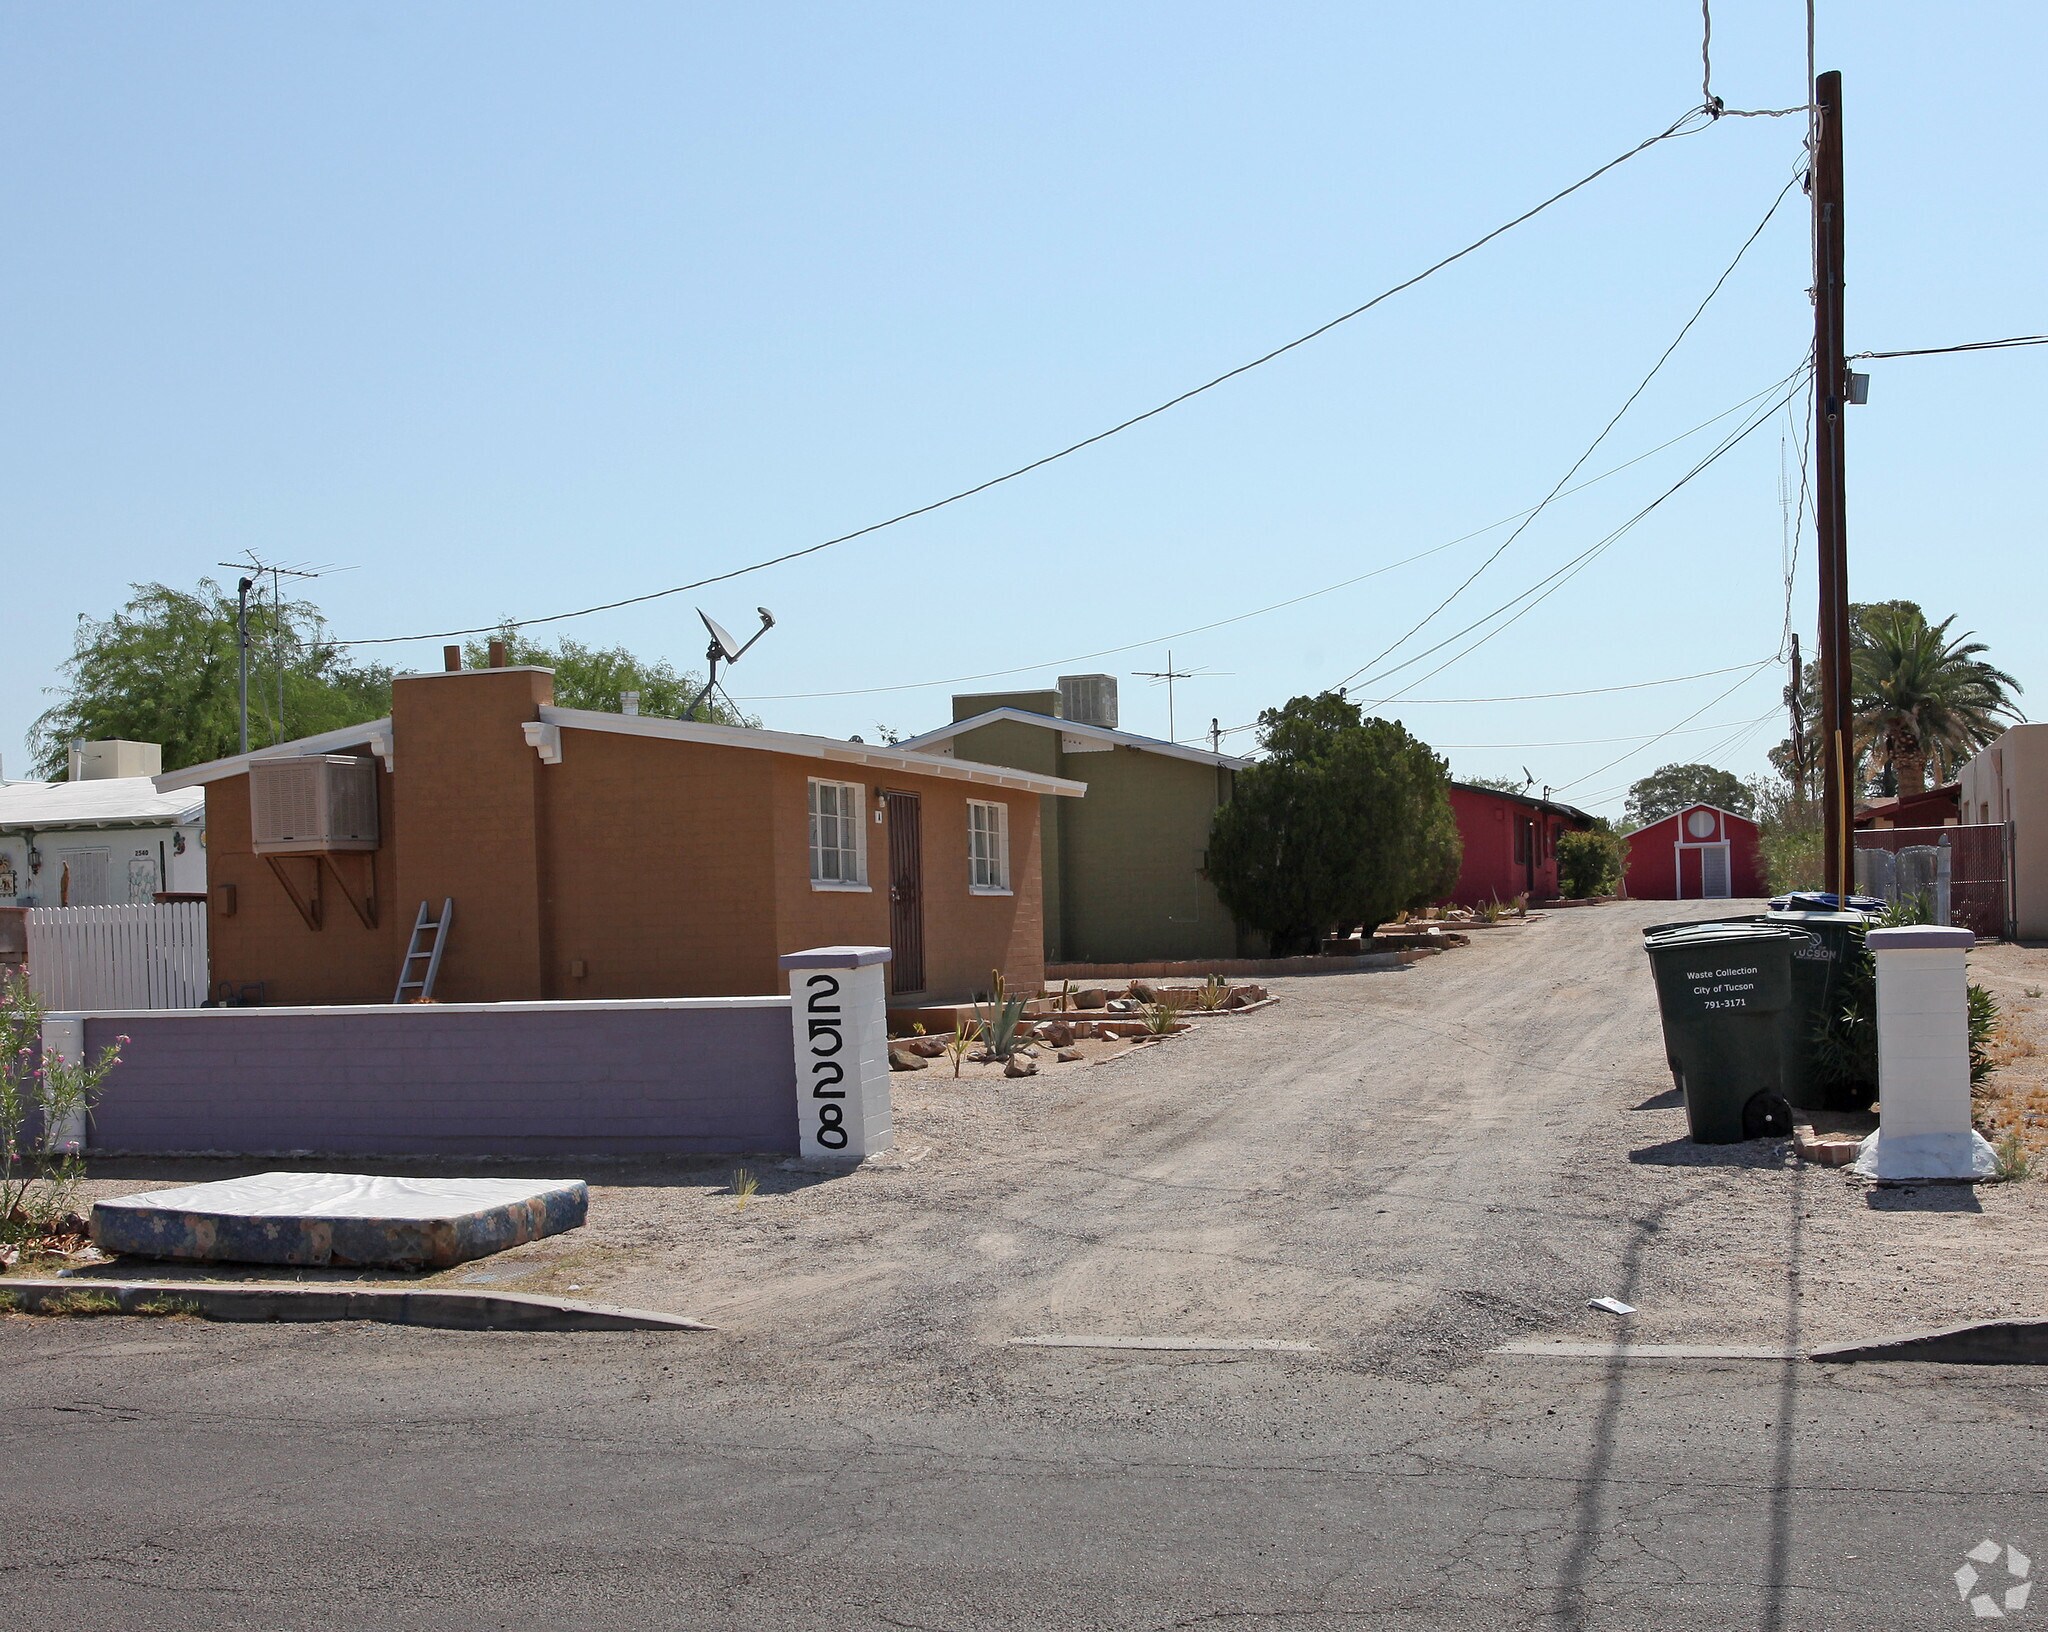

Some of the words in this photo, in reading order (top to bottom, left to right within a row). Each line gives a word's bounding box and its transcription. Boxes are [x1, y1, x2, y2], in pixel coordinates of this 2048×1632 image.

[1686, 971, 1713, 979] Waste
[1715, 967, 1758, 977] Collection
[1693, 986, 1711, 995] City
[1713, 984, 1723, 993] of
[1724, 983, 1754, 992] Tucson
[1704, 998, 1746, 1009] 791-3171
[806, 974, 849, 1150] 2528
